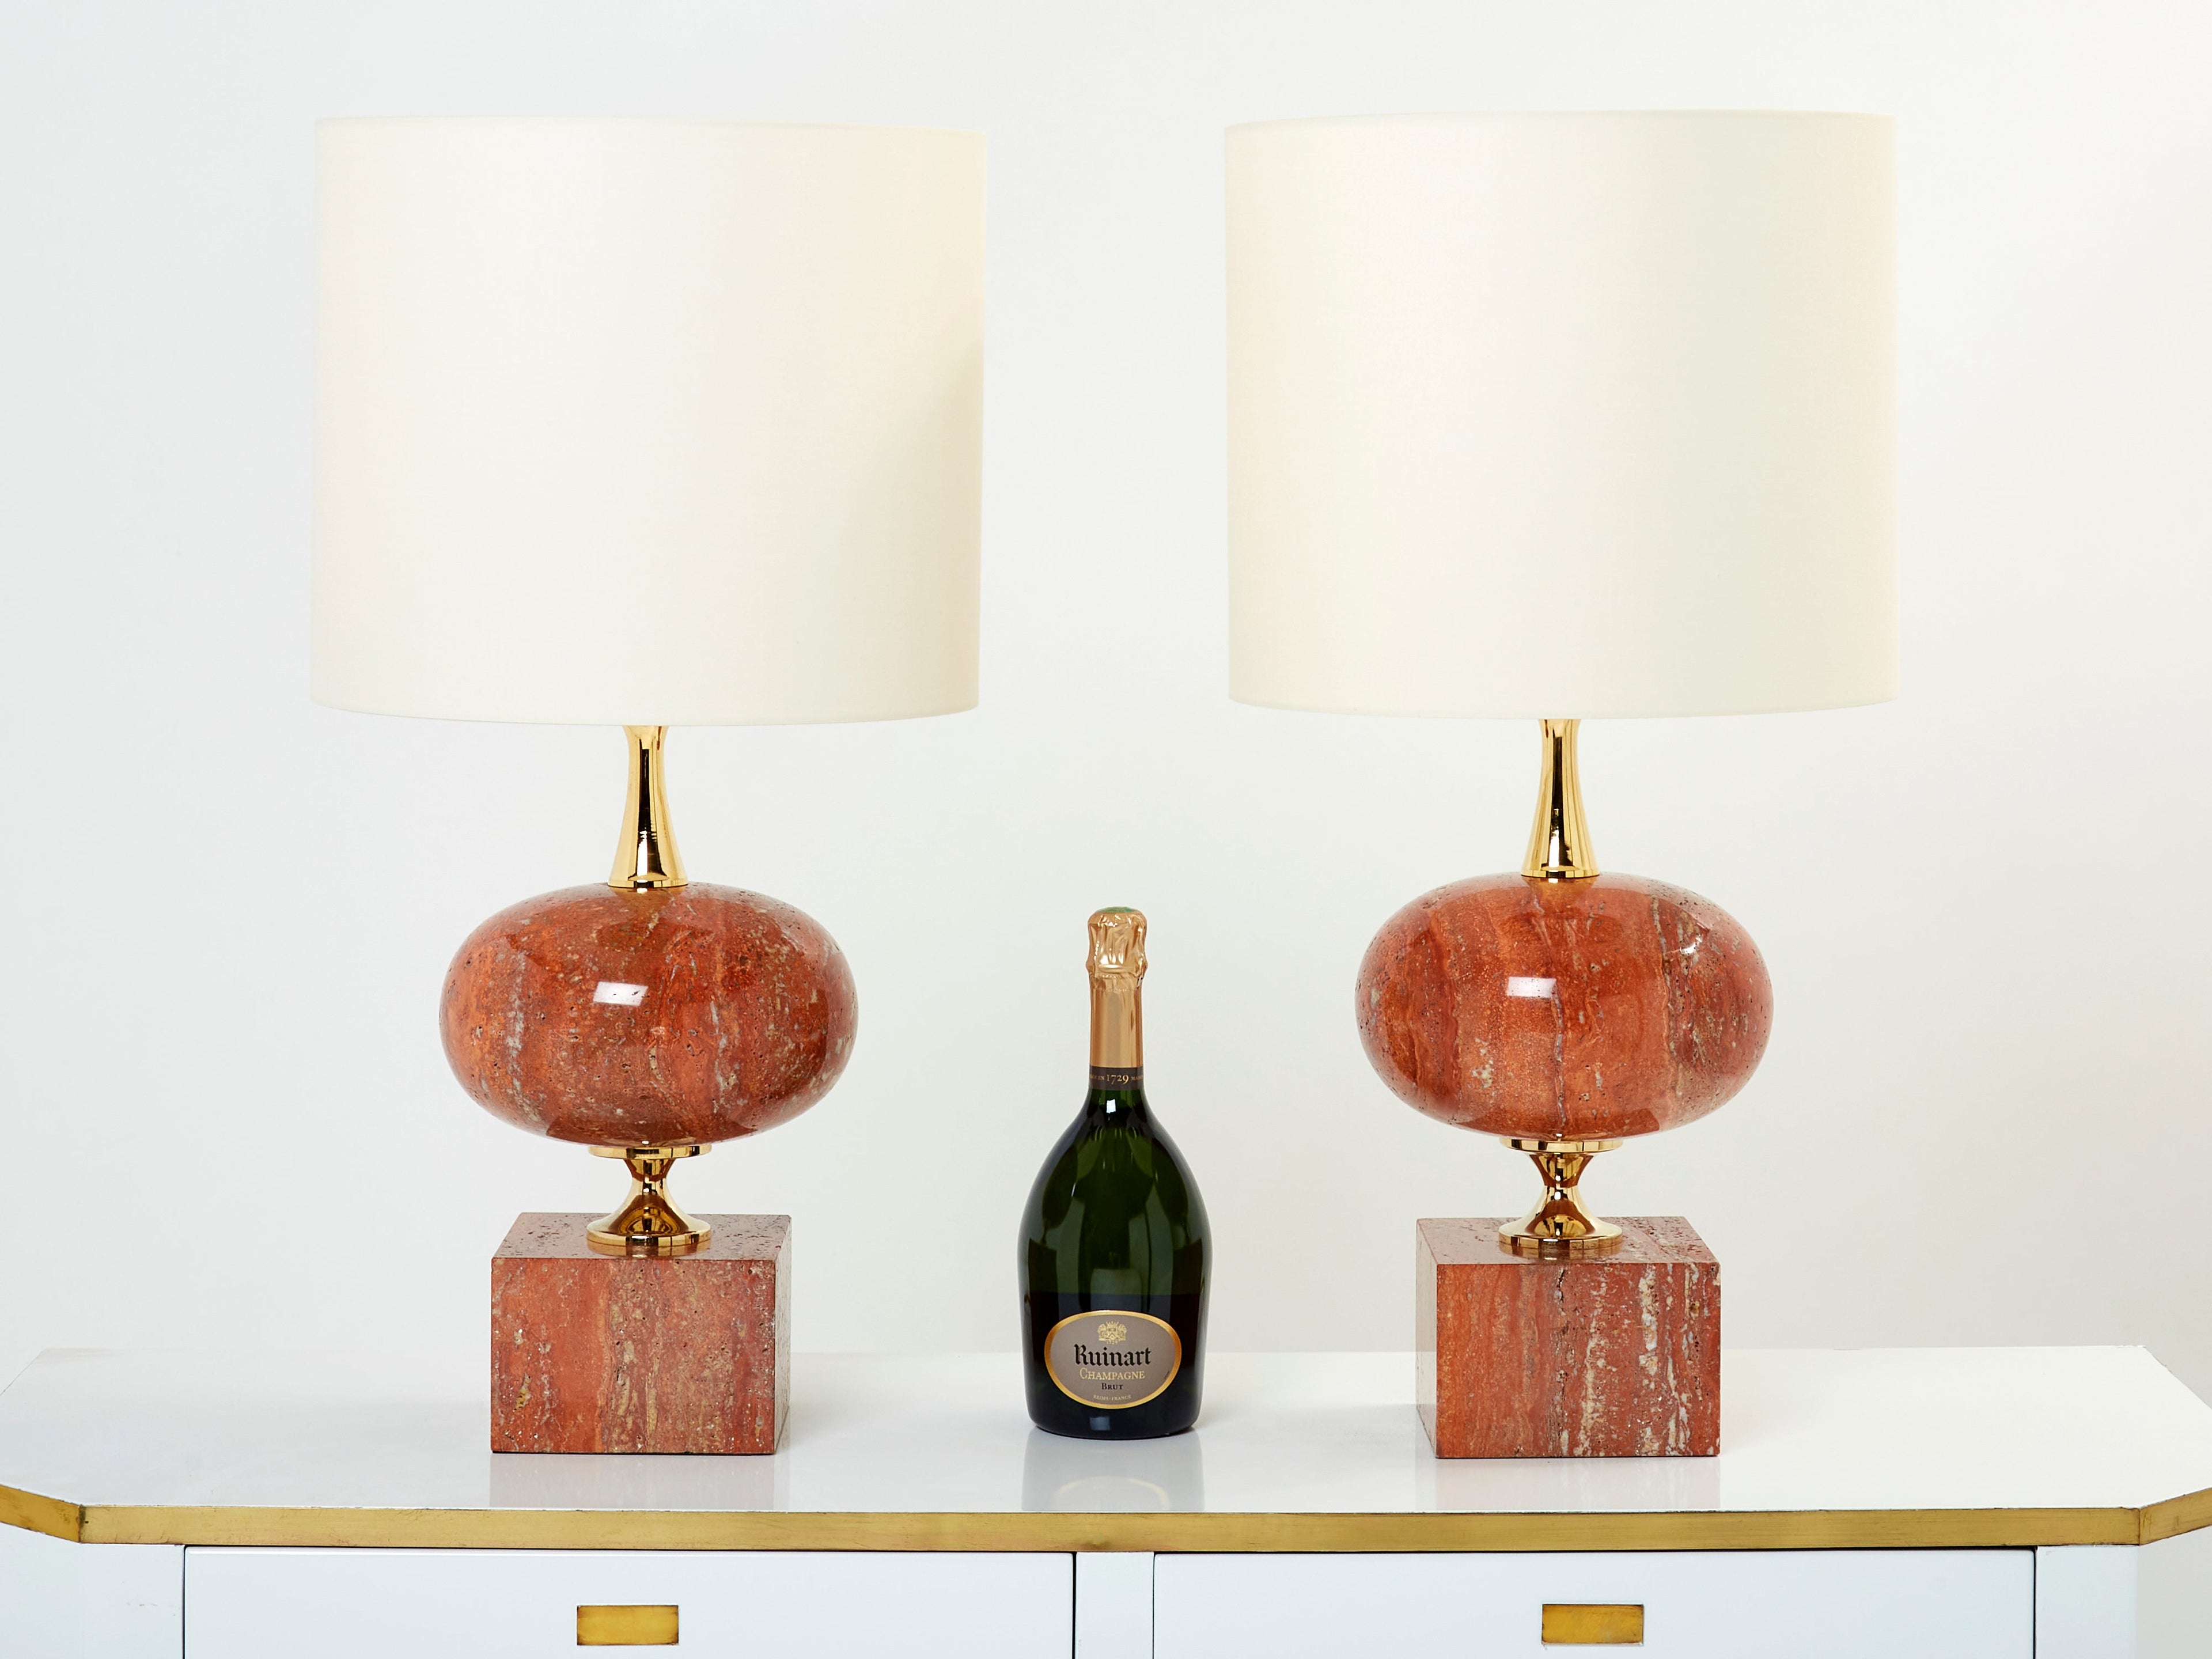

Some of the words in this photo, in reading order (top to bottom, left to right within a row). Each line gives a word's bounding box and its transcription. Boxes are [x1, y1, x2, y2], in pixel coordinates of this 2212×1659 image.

[1107, 1074, 1129, 1085] 1729
[1074, 1344, 1152, 1366] Ruinart
[1080, 1368, 1145, 1380] CHAMPAGNE
